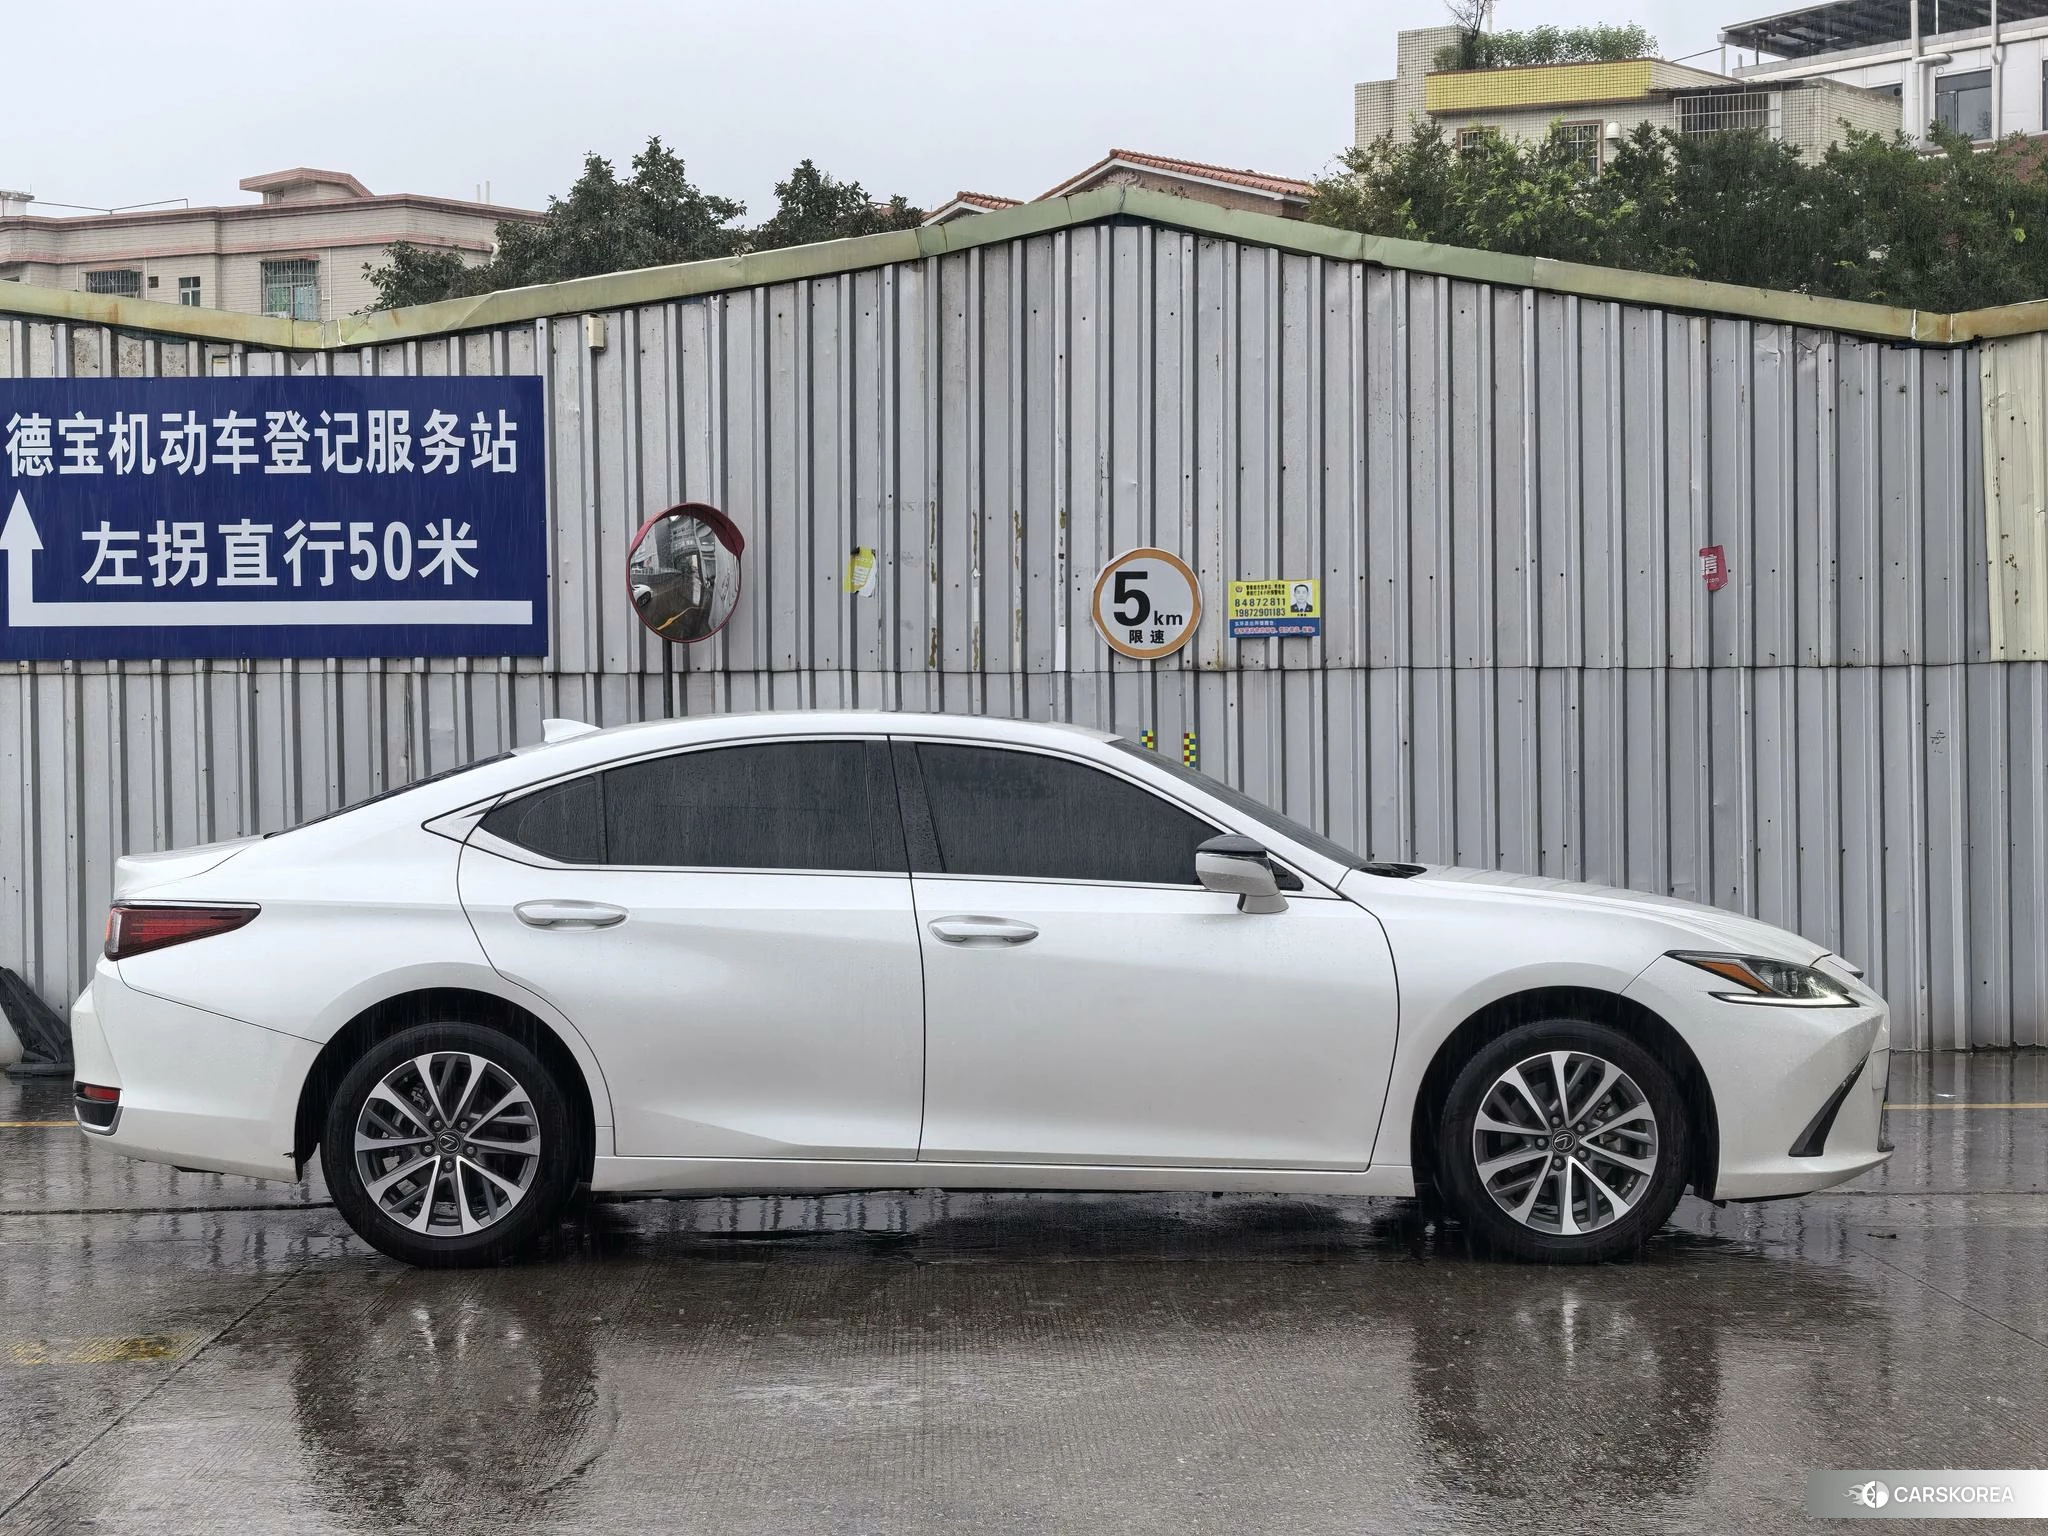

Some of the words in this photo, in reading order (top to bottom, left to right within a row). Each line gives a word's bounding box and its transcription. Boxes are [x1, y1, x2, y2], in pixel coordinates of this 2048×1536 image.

[5, 409, 518, 477] 德宝机动车登记服务站
[81, 518, 480, 587] 左拐直行50米
[1113, 571, 1151, 626] 5
[1153, 610, 1183, 626] km
[1234, 599, 1286, 607] 84872811
[1235, 608, 1286, 617] 19872901183
